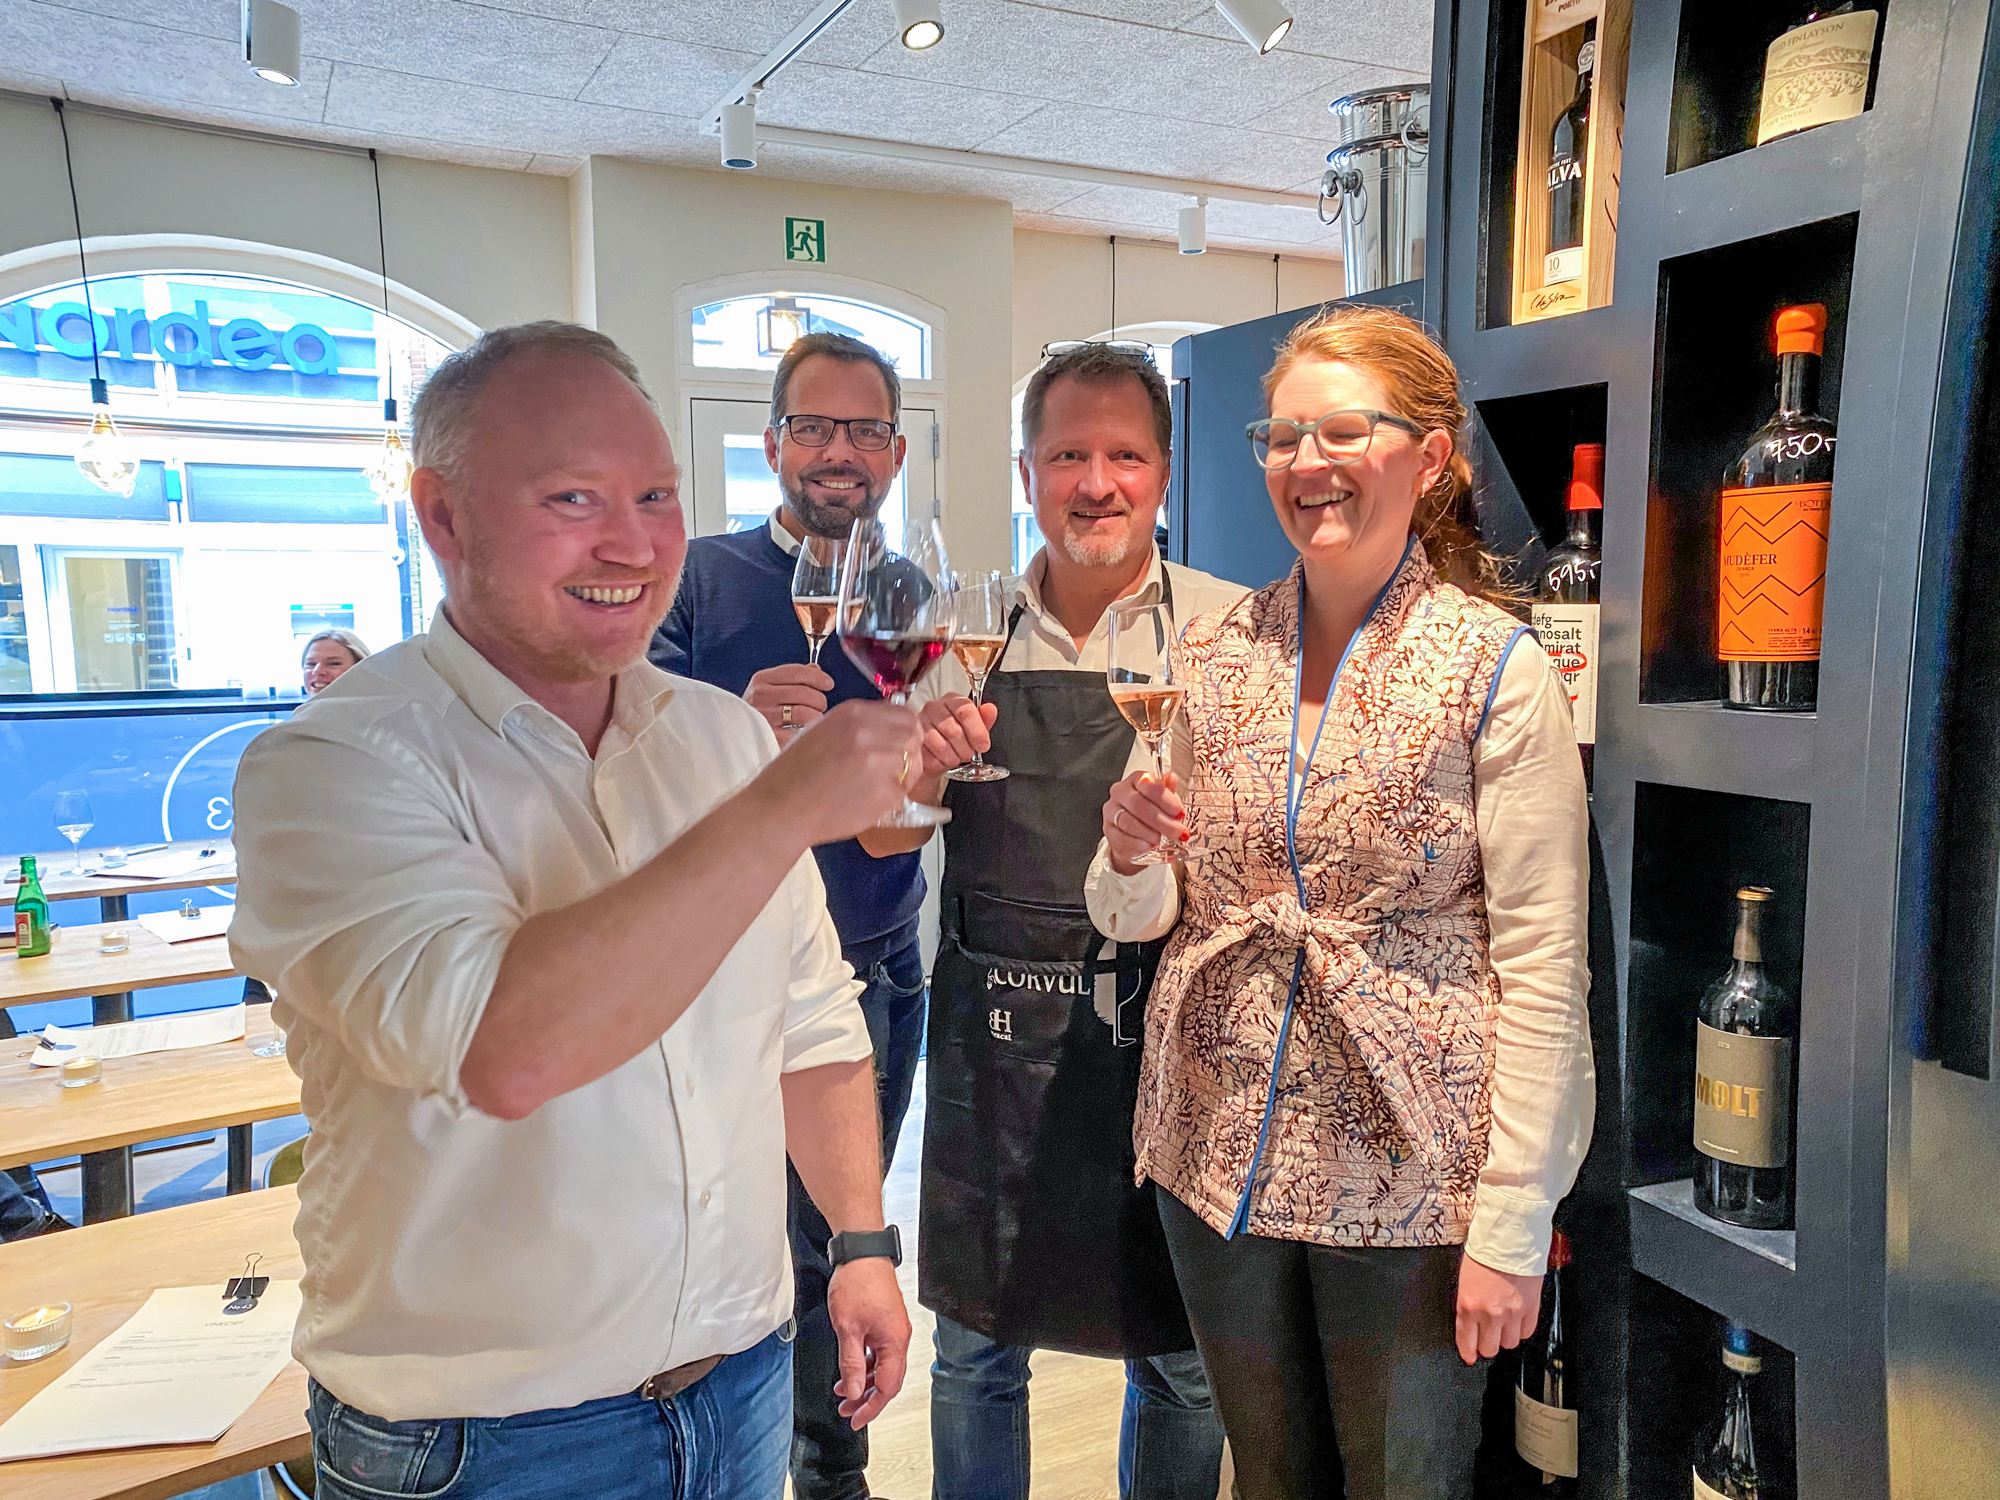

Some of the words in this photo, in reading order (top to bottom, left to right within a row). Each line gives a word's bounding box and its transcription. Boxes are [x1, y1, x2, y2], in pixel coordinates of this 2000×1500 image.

[1787, 22, 1844, 46] FINLAYSON
[1780, 106, 1814, 121] VINTAGE
[1547, 161, 1582, 188] ALVA
[1549, 256, 1560, 271] 10
[1723, 552, 1778, 566] MUDÈFER
[1540, 640, 1581, 654] mirat
[1696, 1071, 1765, 1118] MOLT
